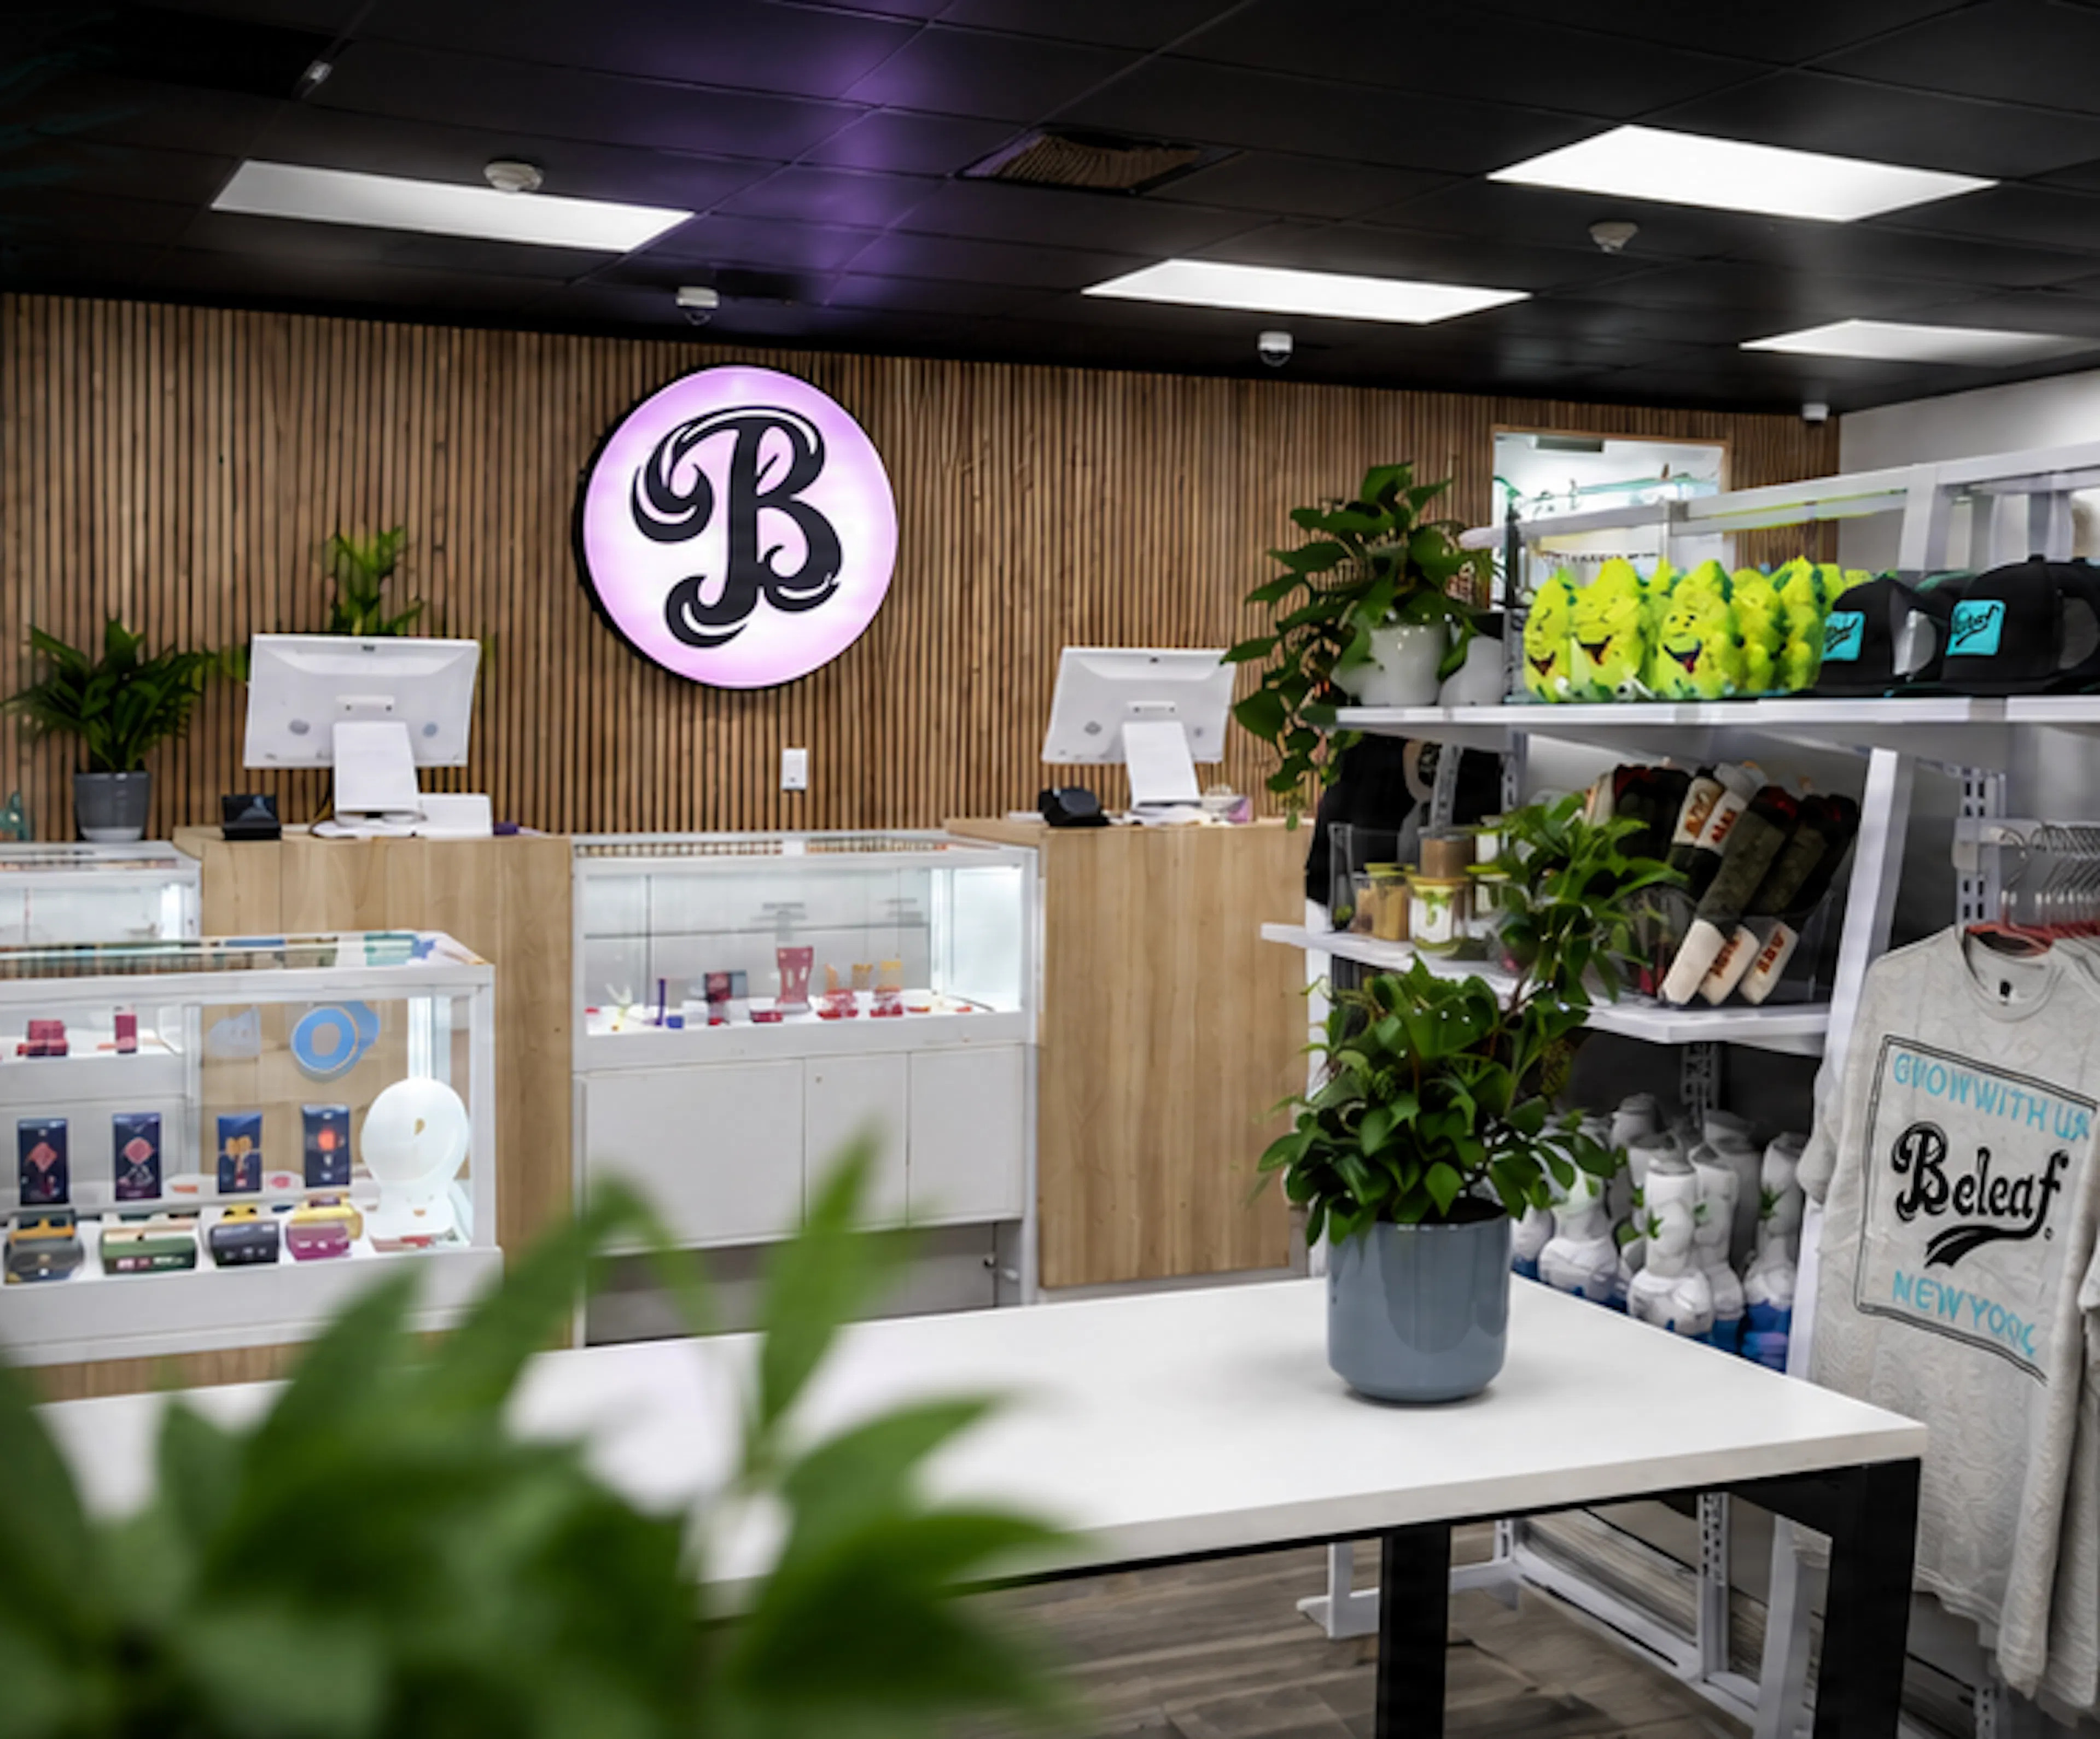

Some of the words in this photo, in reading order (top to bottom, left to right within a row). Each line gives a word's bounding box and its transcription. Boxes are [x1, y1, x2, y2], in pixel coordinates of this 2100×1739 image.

[630, 405, 843, 648] B
[1891, 1121, 2069, 1269] Beleaf
[1892, 1269, 1965, 1321] NEW
